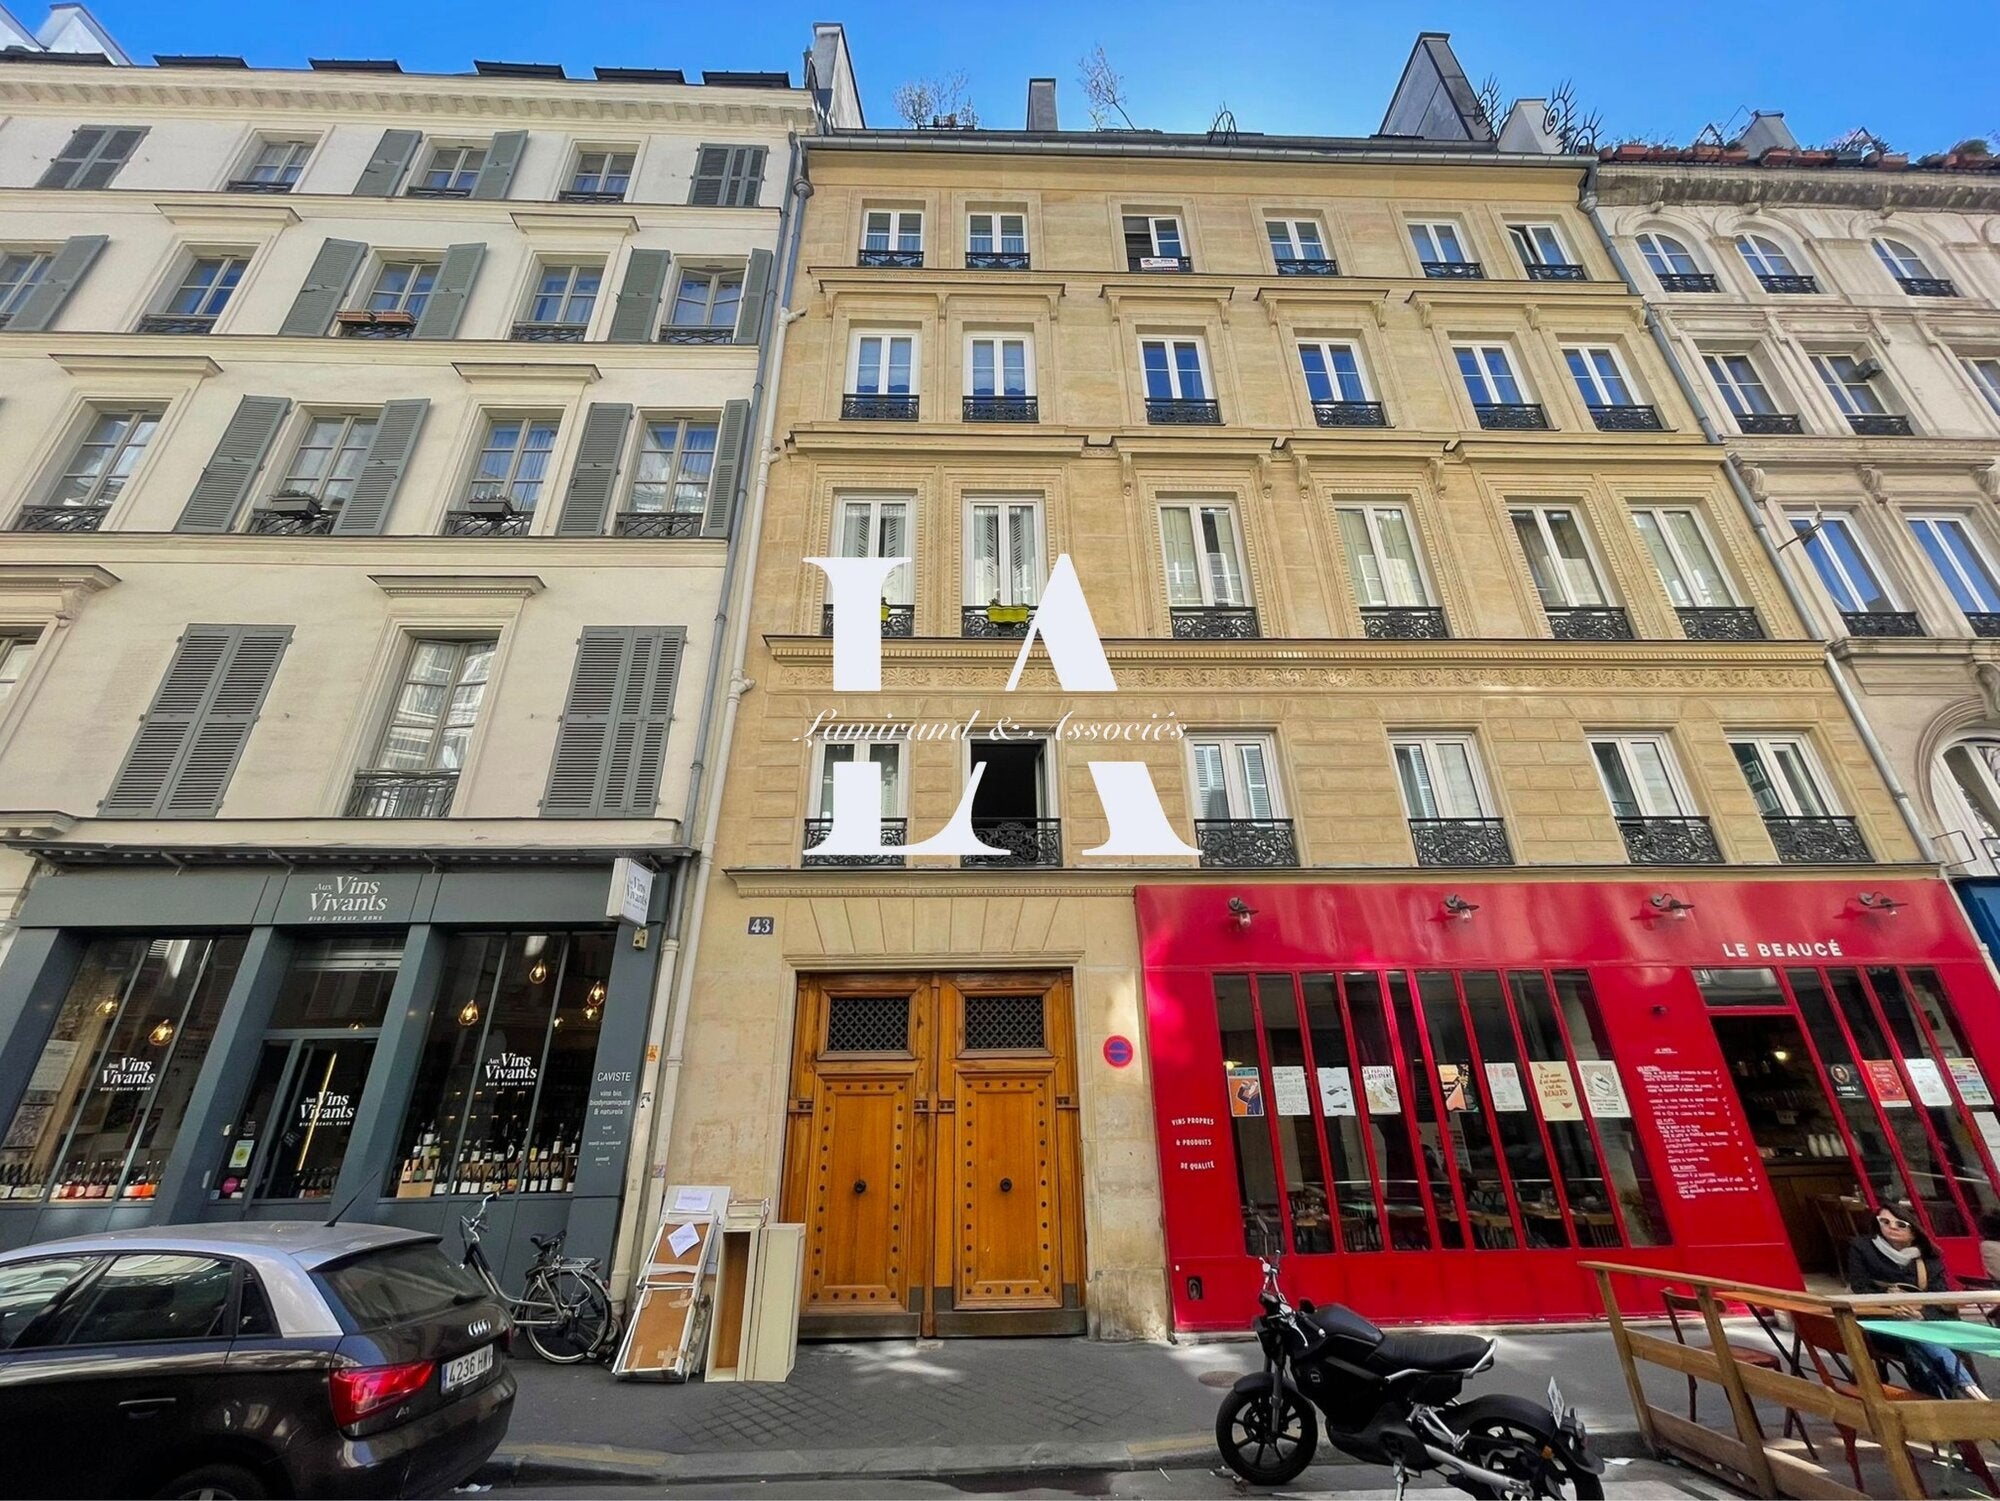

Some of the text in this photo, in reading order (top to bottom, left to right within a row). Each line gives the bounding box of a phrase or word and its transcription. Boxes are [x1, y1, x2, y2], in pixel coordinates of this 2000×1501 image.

[336, 875, 381, 895] Vins
[310, 892, 388, 911] Vivants
[750, 918, 771, 934] 43
[1721, 938, 1844, 958] LE BEAUCÉ
[121, 1057, 152, 1071] Vins
[501, 1052, 532, 1067] Vins
[103, 1070, 156, 1084] Vivants
[485, 1064, 538, 1079] Vivants
[597, 1071, 632, 1082] CAVISTE
[318, 1091, 350, 1106] Vins
[300, 1104, 355, 1119] Vivants
[1171, 1117, 1215, 1126] VINS PROPRES
[1182, 1138, 1212, 1146] PRODUITS
[1180, 1161, 1188, 1170] DE
[449, 1355, 476, 1383] 4236
[395, 1406, 410, 1419] A1
